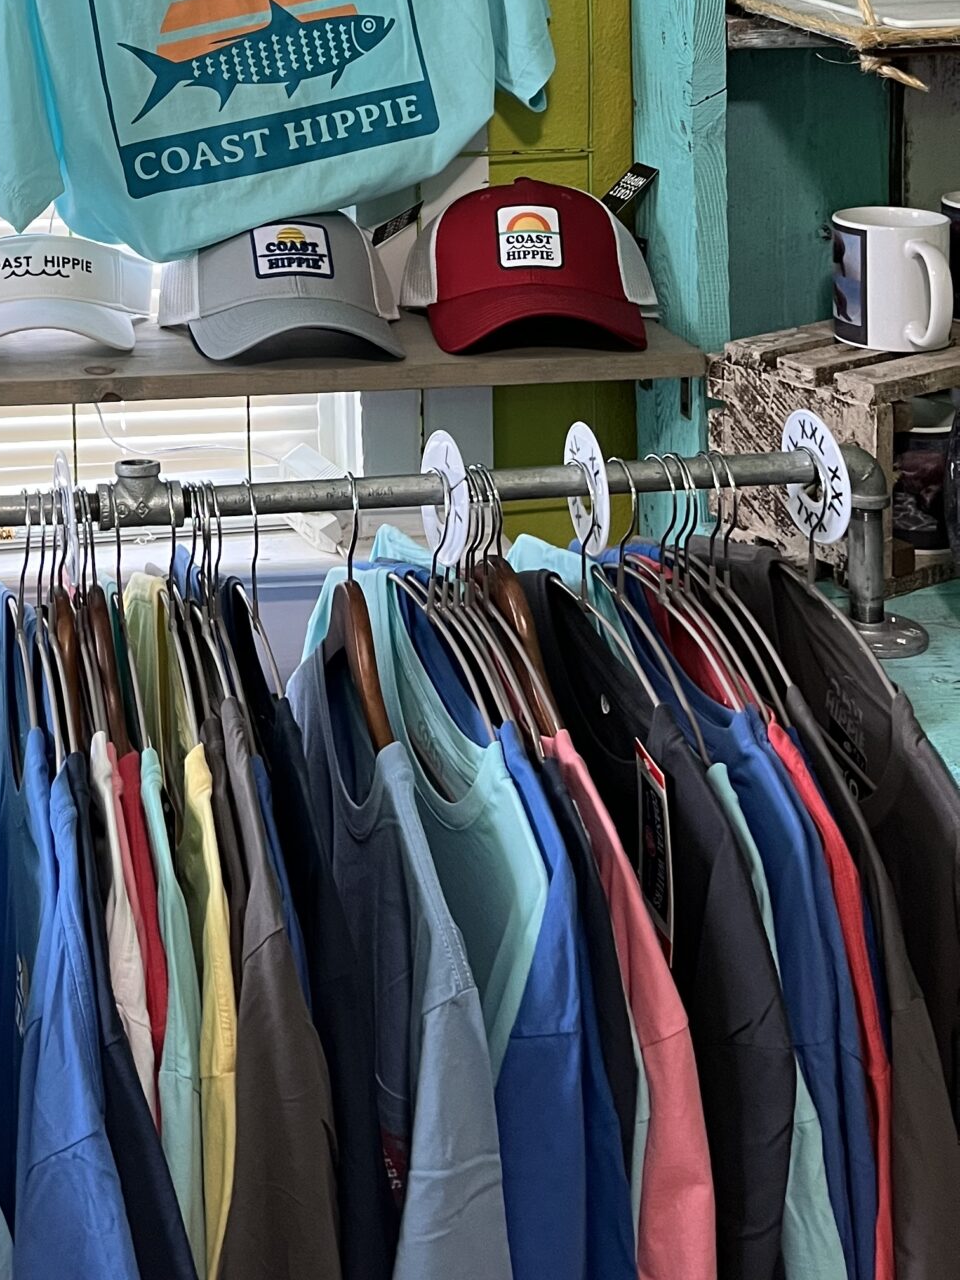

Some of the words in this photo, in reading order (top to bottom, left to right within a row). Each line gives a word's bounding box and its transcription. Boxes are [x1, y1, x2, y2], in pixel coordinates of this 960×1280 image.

[134, 128, 270, 181] COAST
[283, 94, 423, 151] HIPPIE
[609, 185, 634, 200] COAST
[265, 239, 320, 254] COAST
[505, 234, 553, 245] COAST
[267, 256, 322, 270] HIPPIE
[506, 250, 555, 261] HIPPIE
[44, 255, 93, 273] HIPPIE
[798, 419, 825, 456] XXL
[827, 466, 844, 517] XXL
